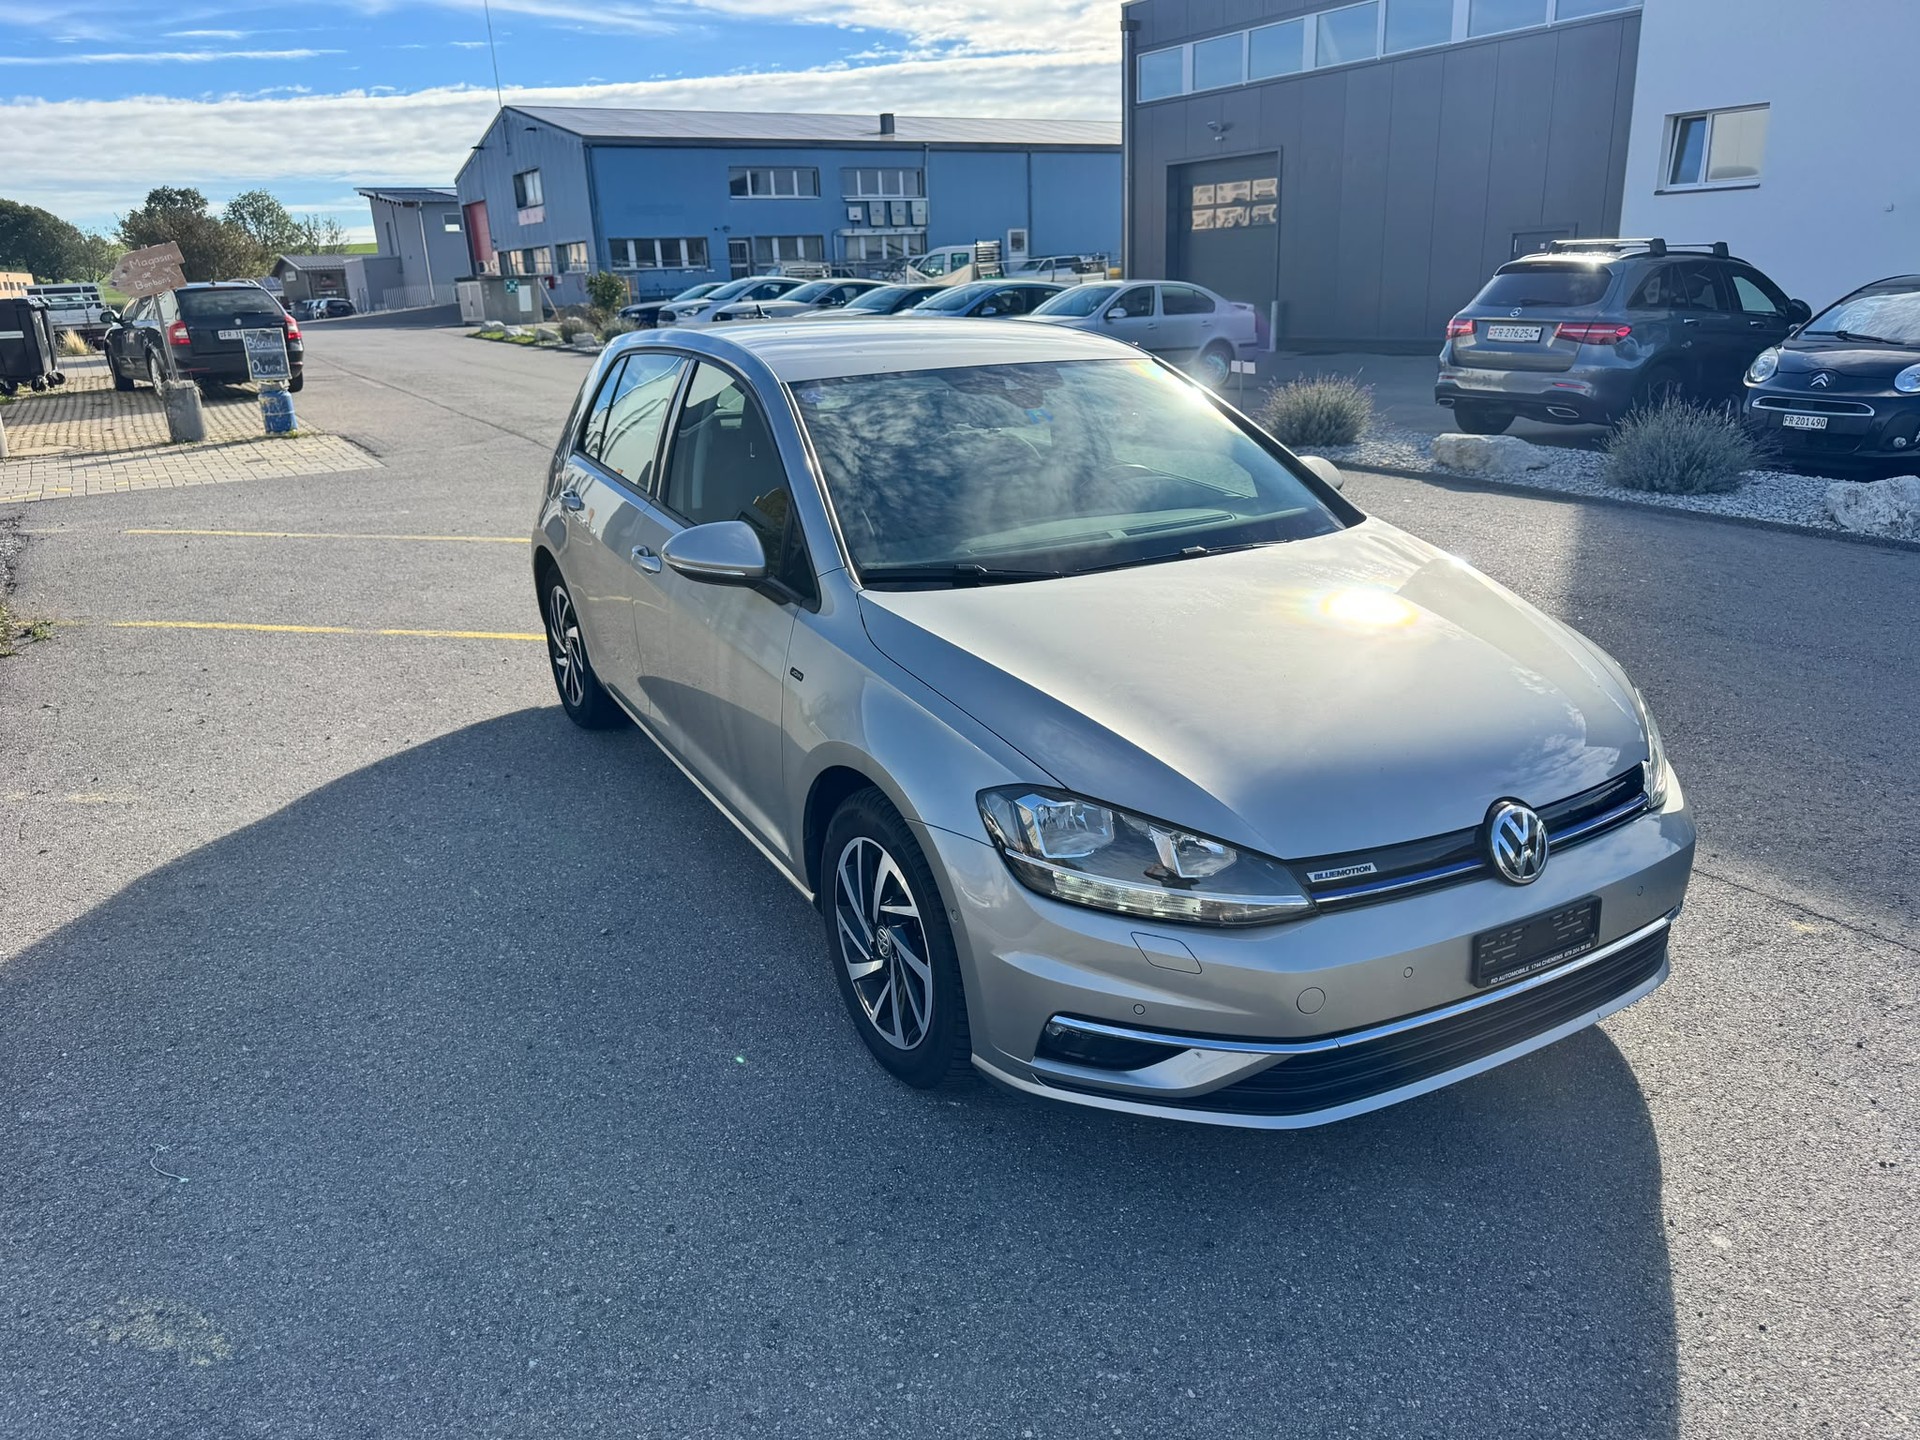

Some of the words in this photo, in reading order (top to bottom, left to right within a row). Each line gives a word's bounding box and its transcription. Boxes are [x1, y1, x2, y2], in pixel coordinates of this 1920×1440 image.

[128, 254, 173, 269] Magasin
[142, 271, 152, 279] de
[134, 277, 171, 290] Bonbons
[1313, 865, 1372, 880] BLUEMOTION
[1499, 966, 1530, 981] AUTOMOBILE
